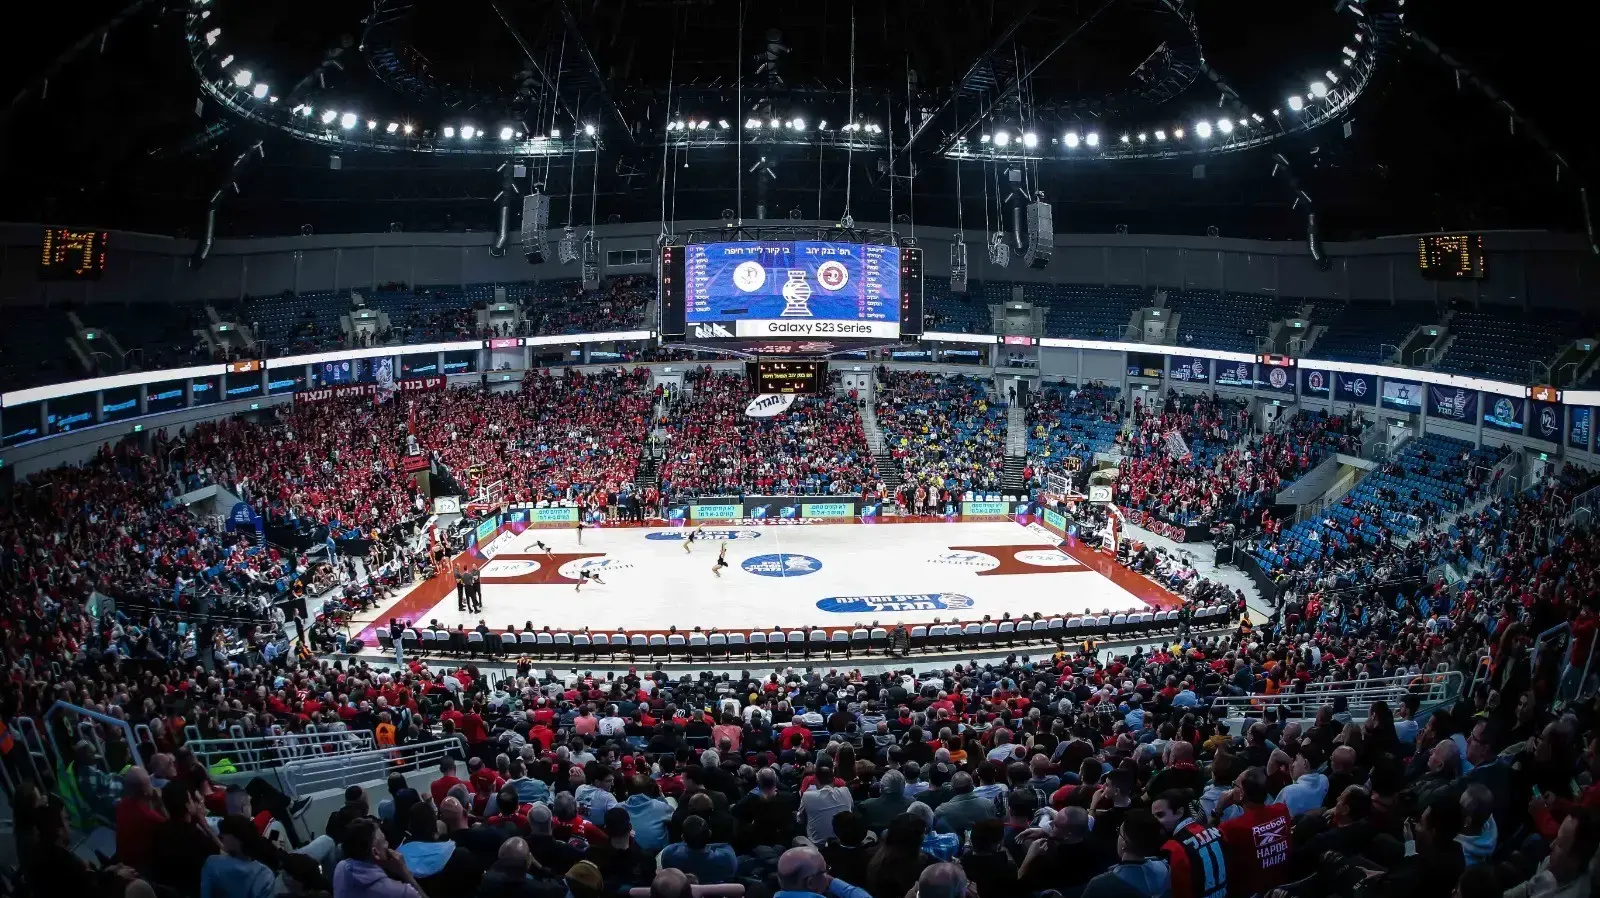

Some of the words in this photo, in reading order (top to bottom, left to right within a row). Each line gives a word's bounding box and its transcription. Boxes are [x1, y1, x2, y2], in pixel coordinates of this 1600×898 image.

[768, 322, 813, 334] Galaxy
[815, 323, 834, 332] S23
[837, 323, 872, 333] Series
[405, 380, 423, 390] בנו
[756, 396, 779, 410] מגדל
[867, 602, 936, 611] מגדל
[1252, 816, 1286, 835] Reebok
[1262, 854, 1286, 869] HAIFA
